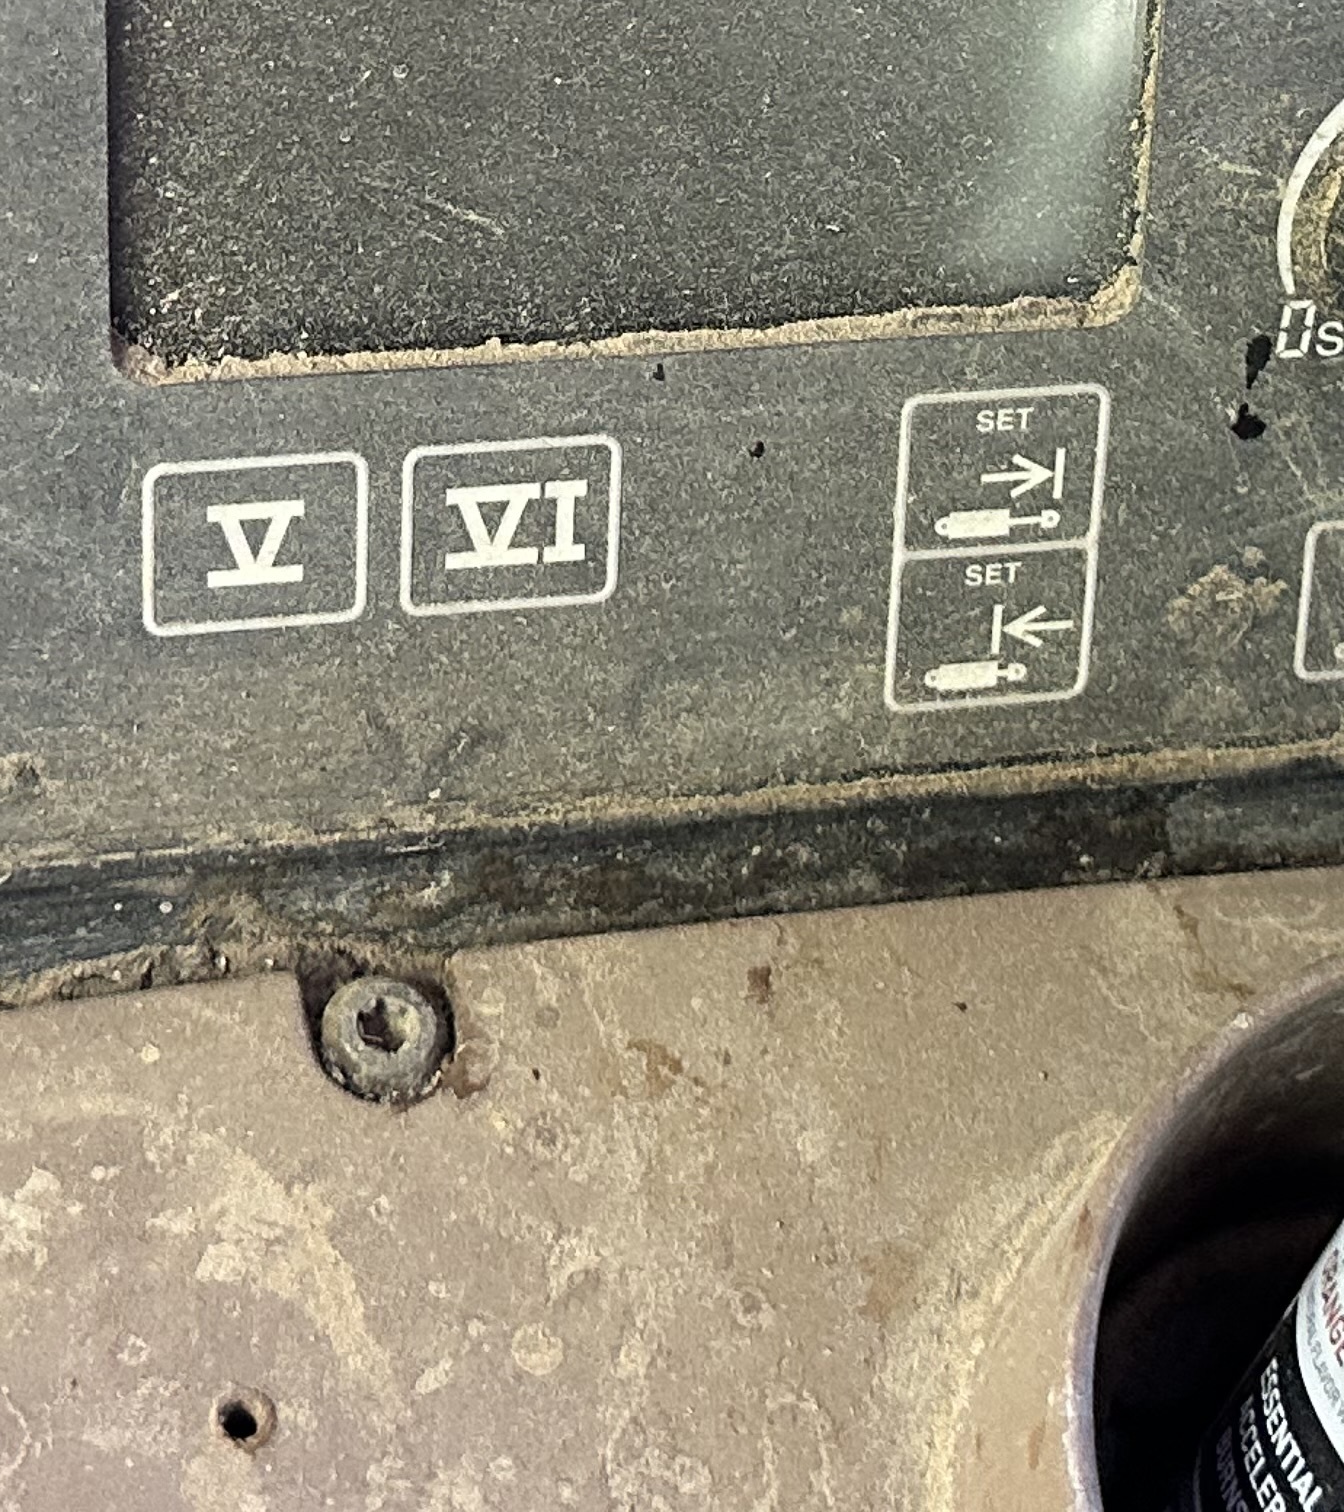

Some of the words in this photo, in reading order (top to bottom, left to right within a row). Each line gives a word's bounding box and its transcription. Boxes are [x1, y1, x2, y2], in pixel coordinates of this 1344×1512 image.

[976, 406, 1035, 434] SET
[207, 500, 305, 588] V
[444, 479, 588, 571] VI
[964, 561, 1022, 587] SET
